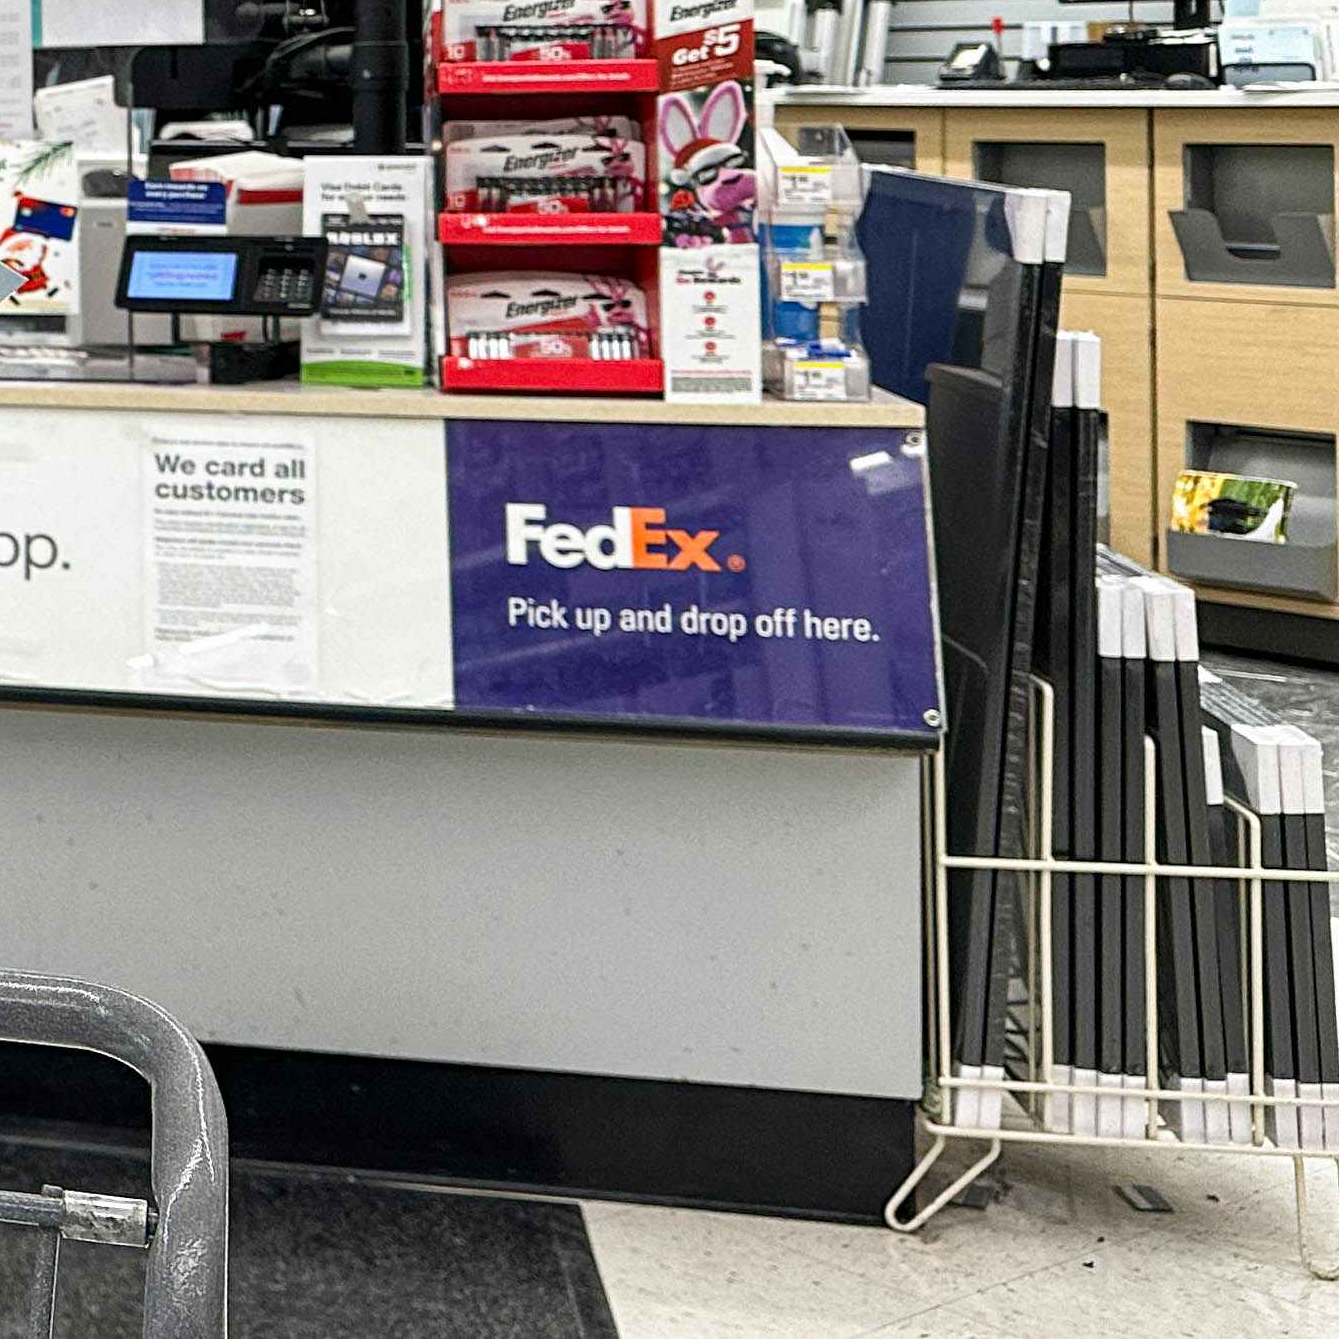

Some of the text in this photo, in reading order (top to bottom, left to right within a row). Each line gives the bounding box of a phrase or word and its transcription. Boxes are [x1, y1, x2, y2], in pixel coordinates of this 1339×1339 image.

[672, 23, 742, 66] Get $5
[503, 147, 579, 172] Energizer
[506, 295, 580, 319] Energizer
[154, 452, 306, 479] We card all
[154, 480, 306, 505] customers
[505, 502, 722, 572] FedEx
[507, 596, 881, 642] Pick up and drop off here.
